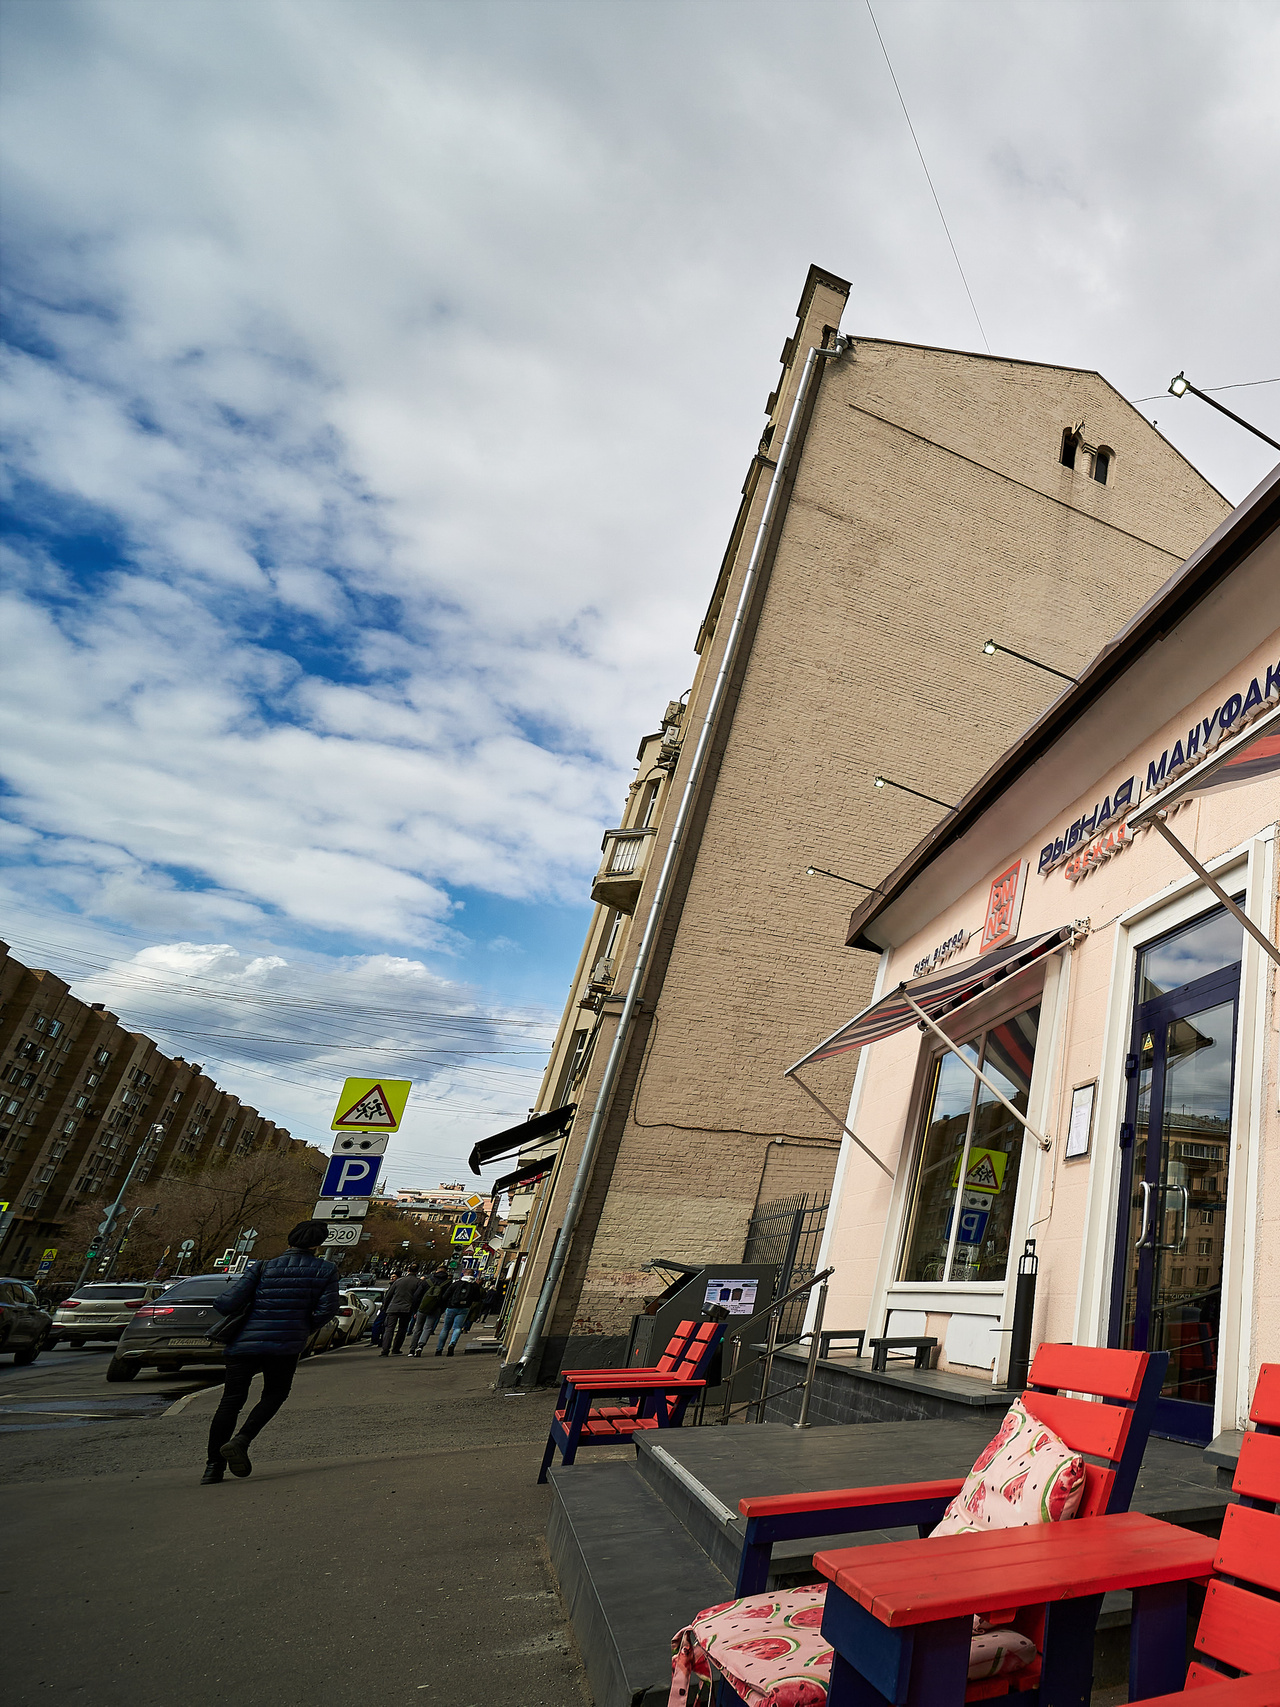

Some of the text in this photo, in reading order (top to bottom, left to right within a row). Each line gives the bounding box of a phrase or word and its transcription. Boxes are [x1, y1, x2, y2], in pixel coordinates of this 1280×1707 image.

[1037, 775, 1136, 875] РЫБНАЯ
[1064, 822, 1128, 880] СВЕЖАЯ
[986, 901, 1011, 940] №1
[933, 929, 964, 961] BISTRO
[336, 1160, 370, 1192] P
[338, 1230, 354, 1240] 20
